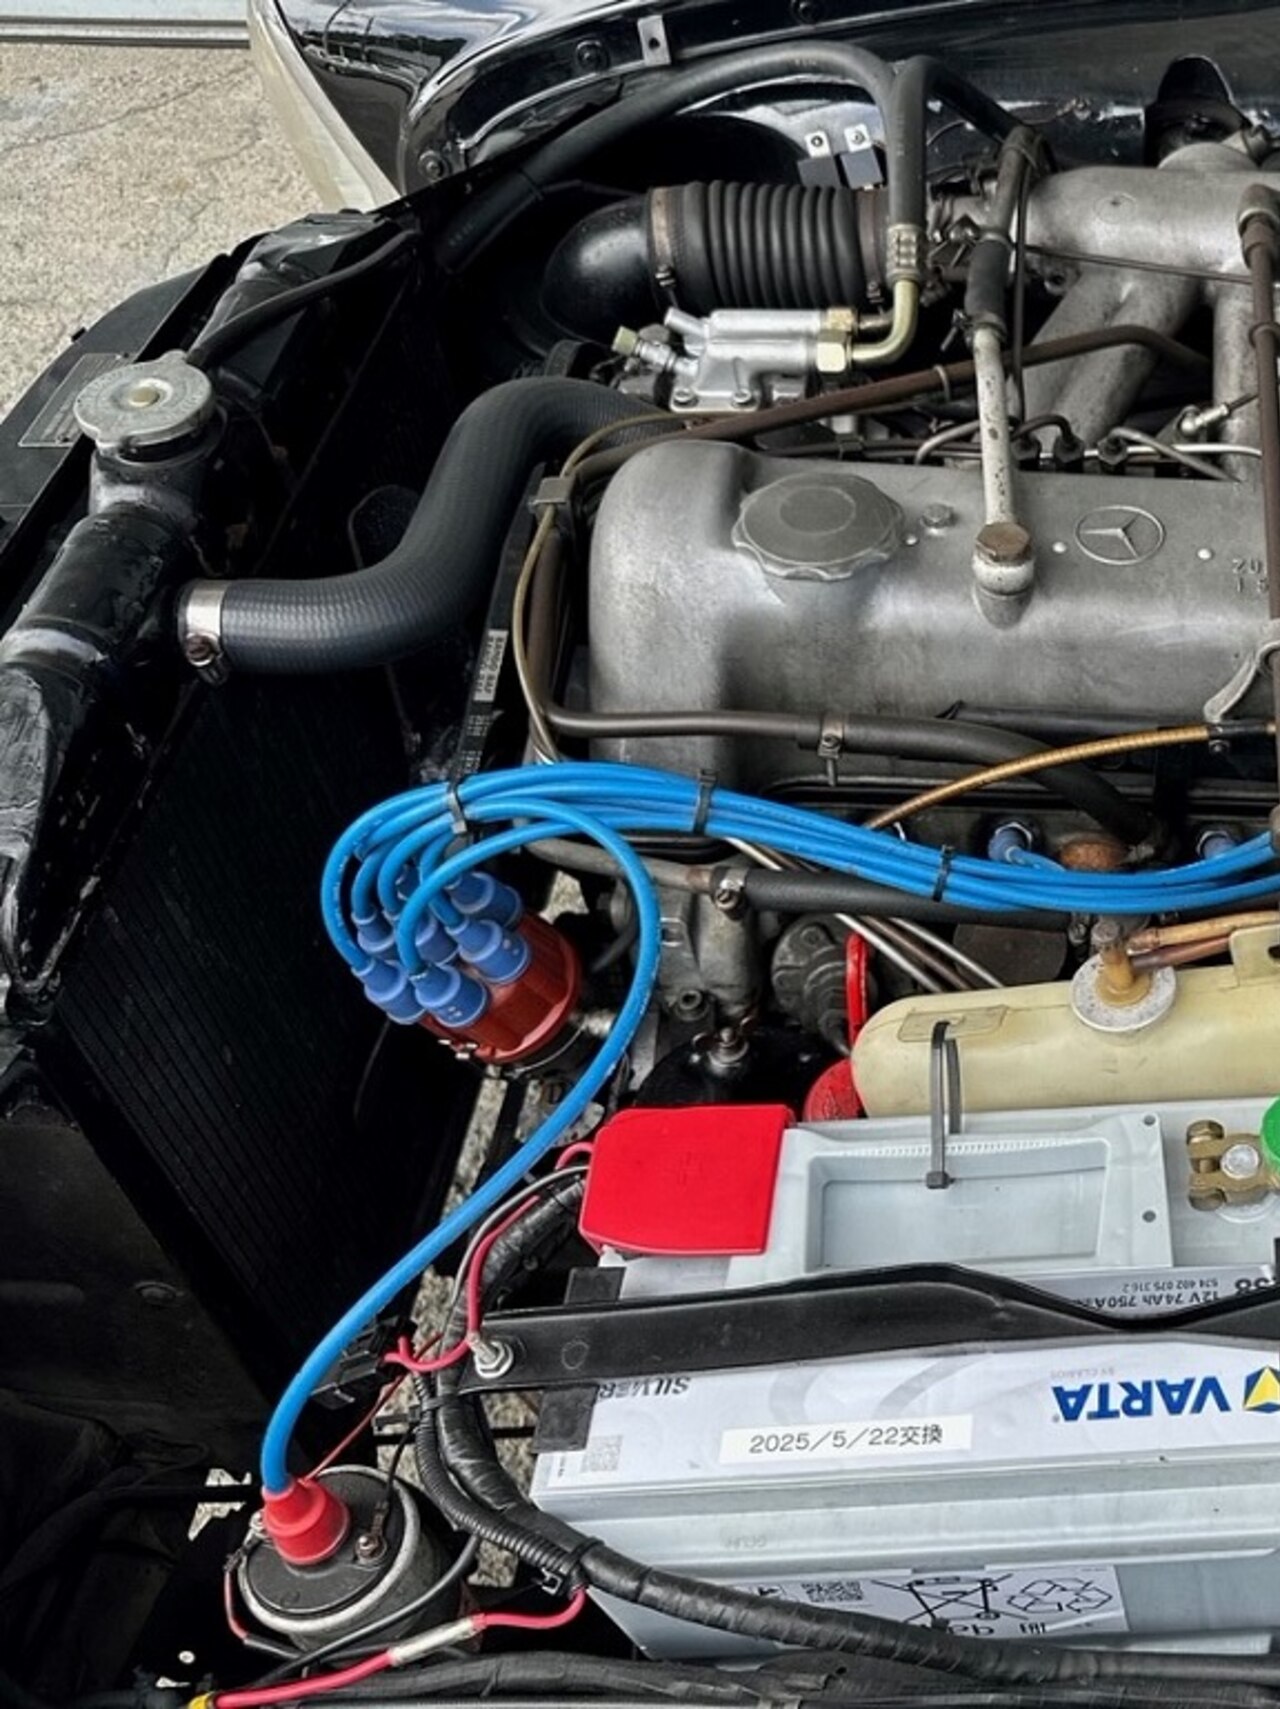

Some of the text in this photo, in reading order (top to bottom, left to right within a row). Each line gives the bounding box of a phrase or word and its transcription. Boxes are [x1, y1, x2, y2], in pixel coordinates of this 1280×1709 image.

[1142, 1292, 1184, 1306] 74Ah
[1191, 1288, 1220, 1304] 12V
[1052, 1375, 1231, 1422] VARTA
